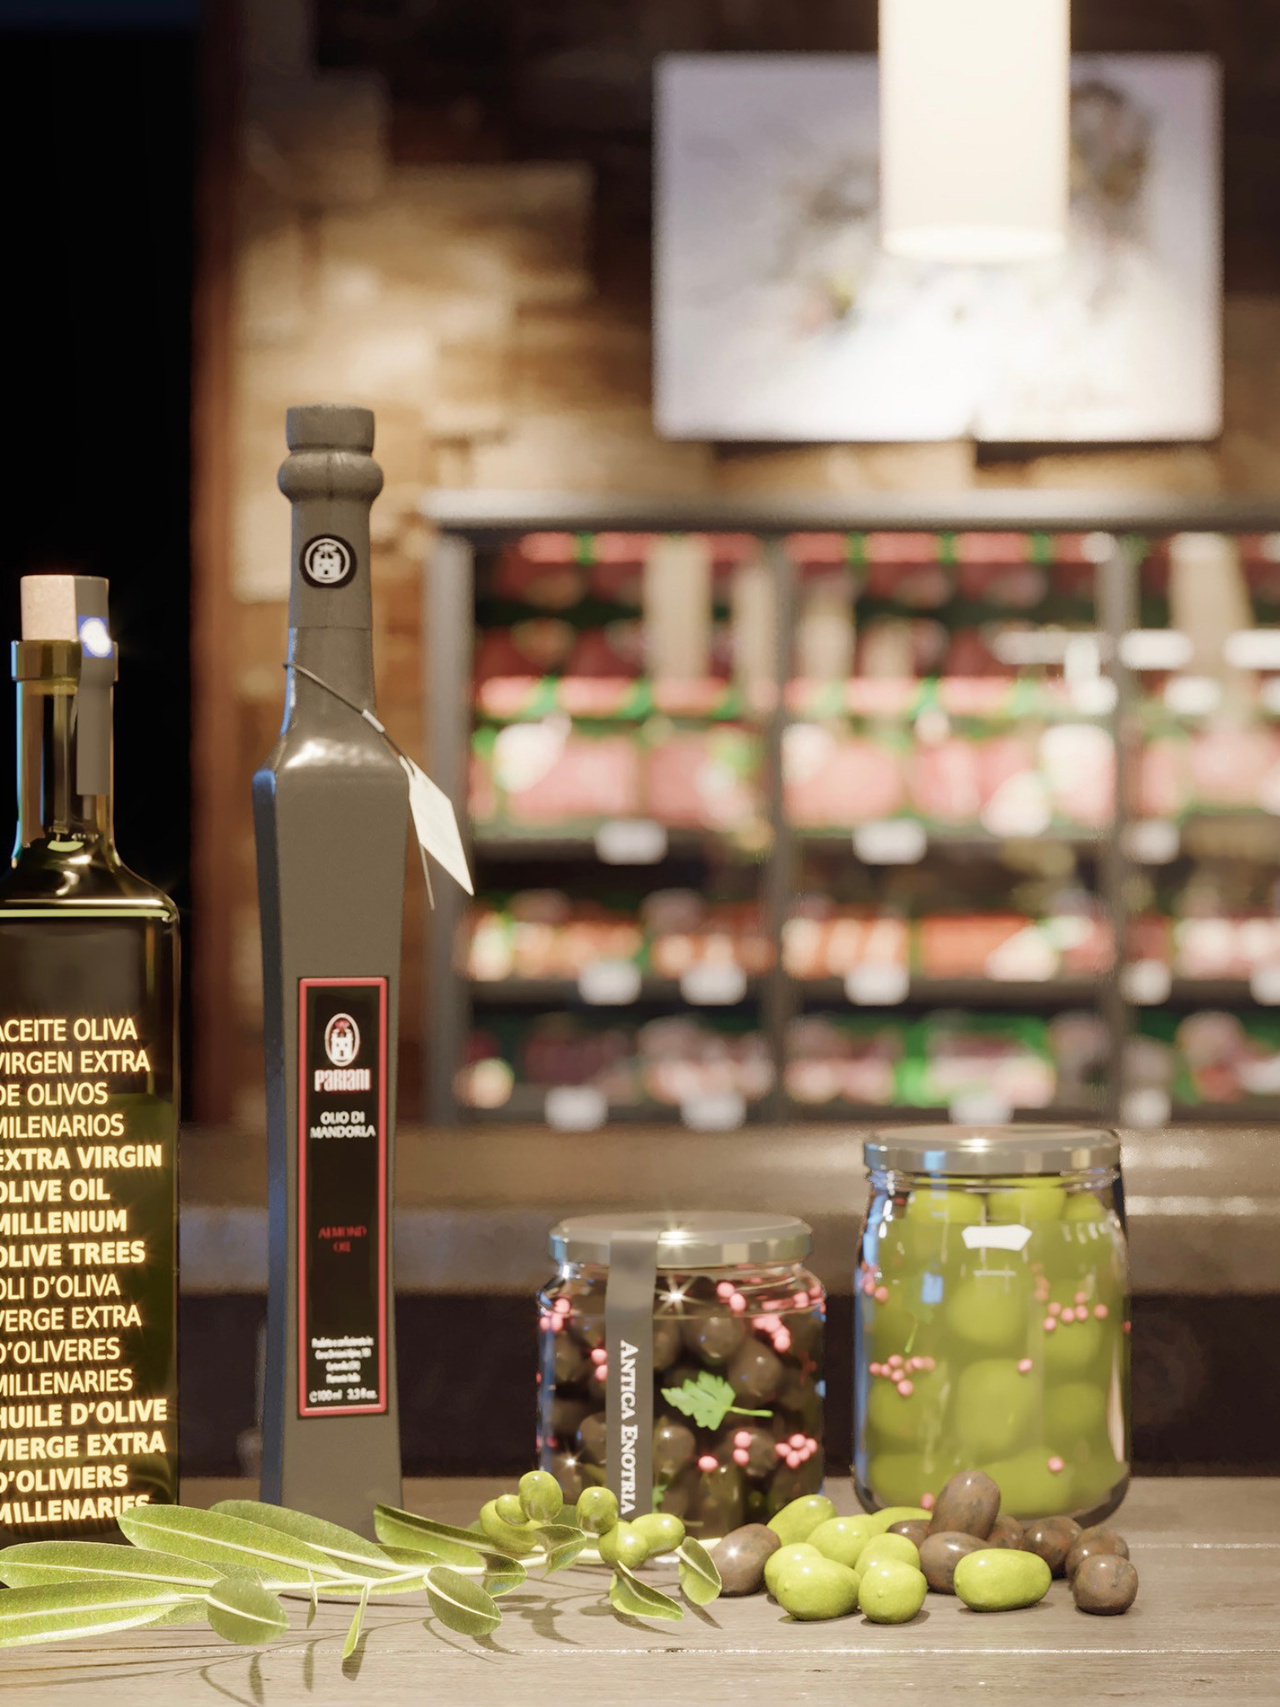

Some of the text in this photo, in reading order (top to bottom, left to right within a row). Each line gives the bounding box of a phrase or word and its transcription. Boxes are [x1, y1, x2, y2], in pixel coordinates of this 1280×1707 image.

[73, 1017, 138, 1042] OLIVA
[80, 1049, 151, 1073] EXTRA
[27, 1082, 108, 1106] OLIVOS
[320, 1110, 366, 1125] OLIO DI
[310, 1124, 377, 1139] MANDORLA
[0, 1144, 162, 1171] XTRA VIRGIN
[69, 1178, 111, 1202] OIL
[68, 1240, 146, 1266] TREES
[71, 1304, 142, 1329] EXTRA
[620, 1339, 639, 1515] ANTICA ENOTRIA
[87, 1430, 167, 1458] EXTRA
